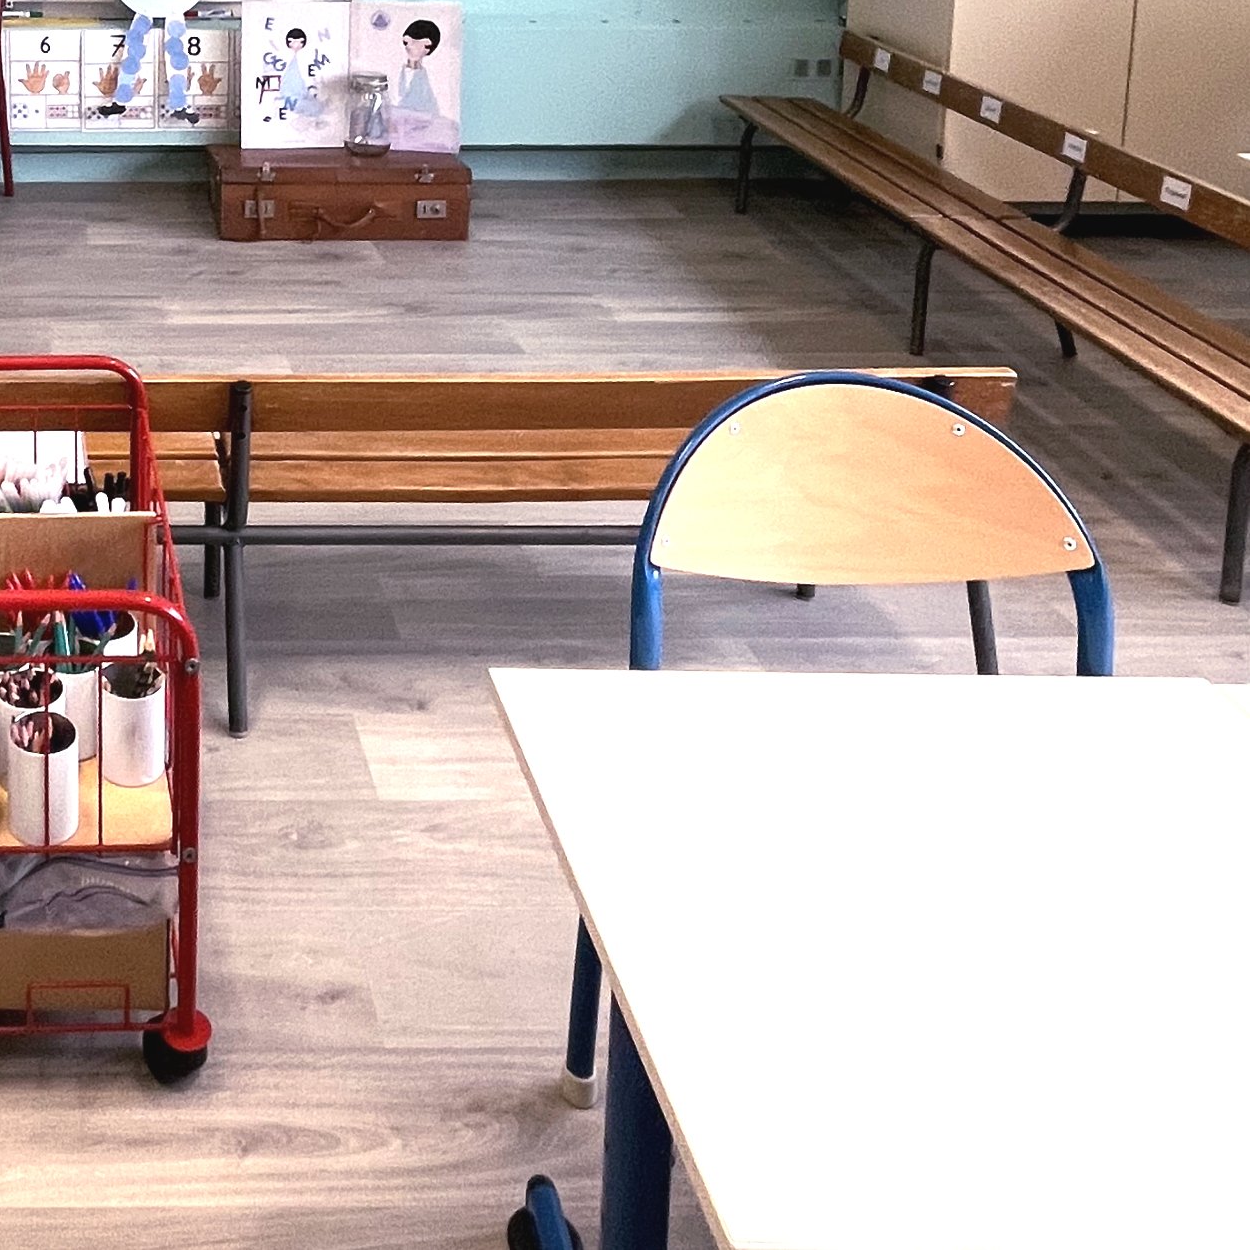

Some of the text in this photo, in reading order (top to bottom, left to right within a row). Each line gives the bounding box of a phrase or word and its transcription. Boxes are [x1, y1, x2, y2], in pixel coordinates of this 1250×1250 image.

[41, 37, 50, 53] 6
[110, 35, 126, 56] 7
[188, 37, 201, 56] 8
